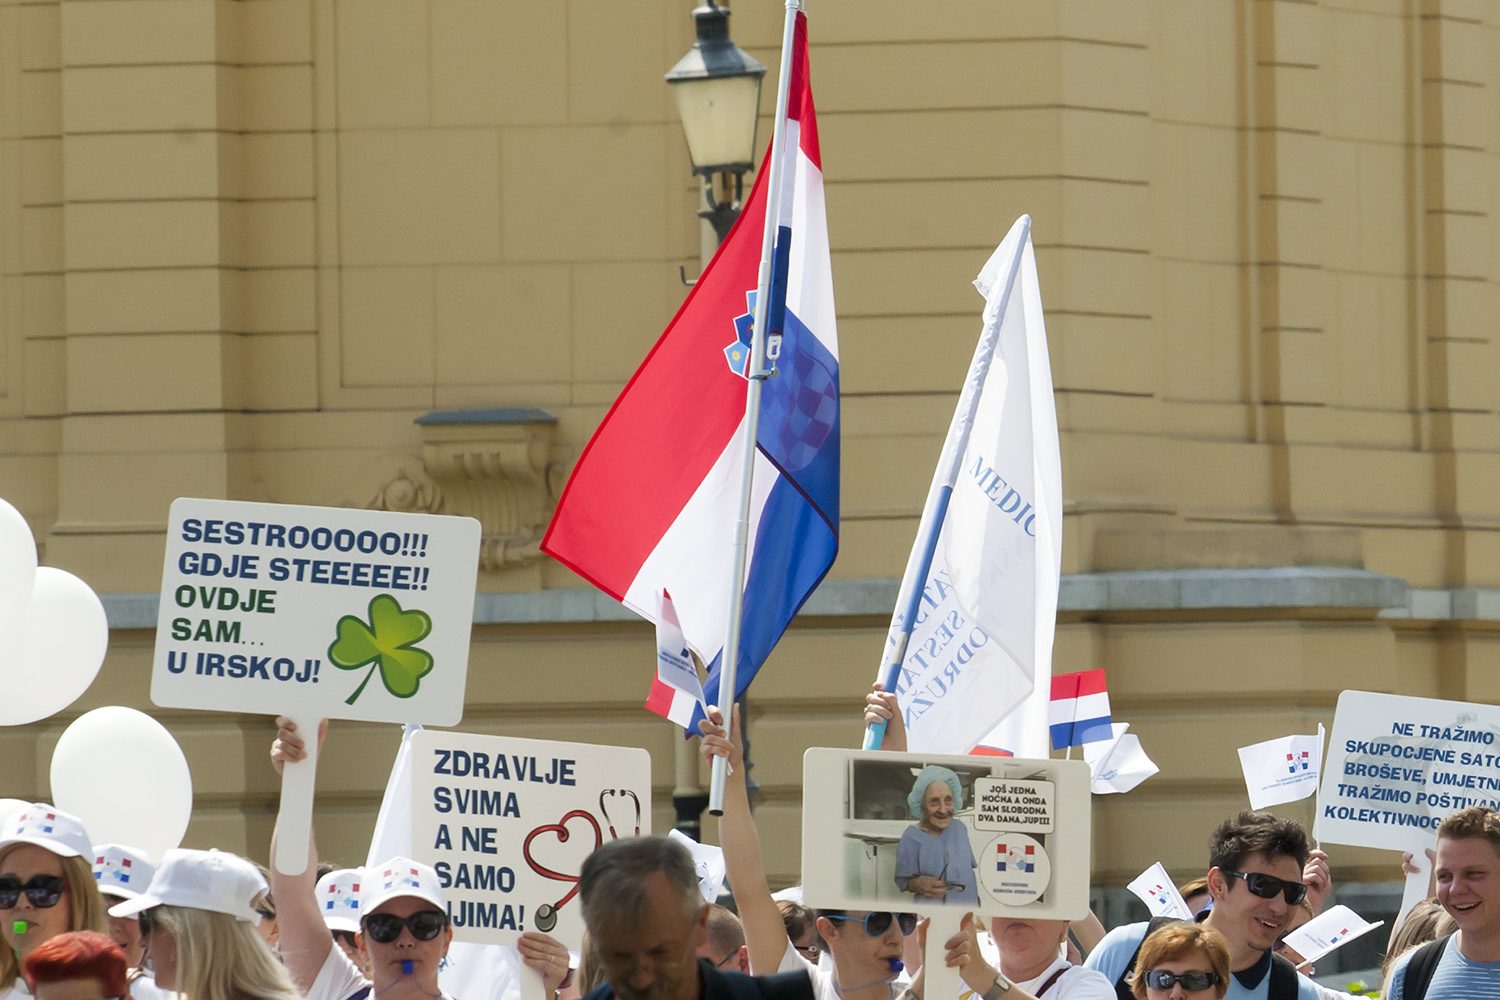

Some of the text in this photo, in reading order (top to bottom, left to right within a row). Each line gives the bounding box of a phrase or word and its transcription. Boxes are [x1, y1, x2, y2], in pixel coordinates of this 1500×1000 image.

[182, 518, 429, 557] SESTROOOOO!!!
[178, 552, 430, 591] GDJE STEEEEE!!
[175, 584, 277, 613] OVDJE
[168, 650, 321, 683] U IRSKOJ!
[1392, 722, 1495, 745] NE TRAŽIMO
[1345, 740, 1455, 763] SKUPOCJENE
[433, 749, 576, 786] ZDRAVLJE
[1344, 762, 1427, 785] BROŠEVE,
[434, 786, 521, 818] SVIMA
[989, 784, 1037, 795] JOŠ JEDNA
[1014, 796, 1021, 804] A
[1022, 797, 1047, 805] ONDA
[1337, 783, 1412, 804] TRAŽIMO
[978, 814, 995, 822] DVA
[981, 804, 1047, 815] SAM SLOBODNA
[1324, 805, 1441, 830] KOLEKTIVNOG
[434, 823, 498, 854] A NE
[434, 861, 515, 893] SAMO
